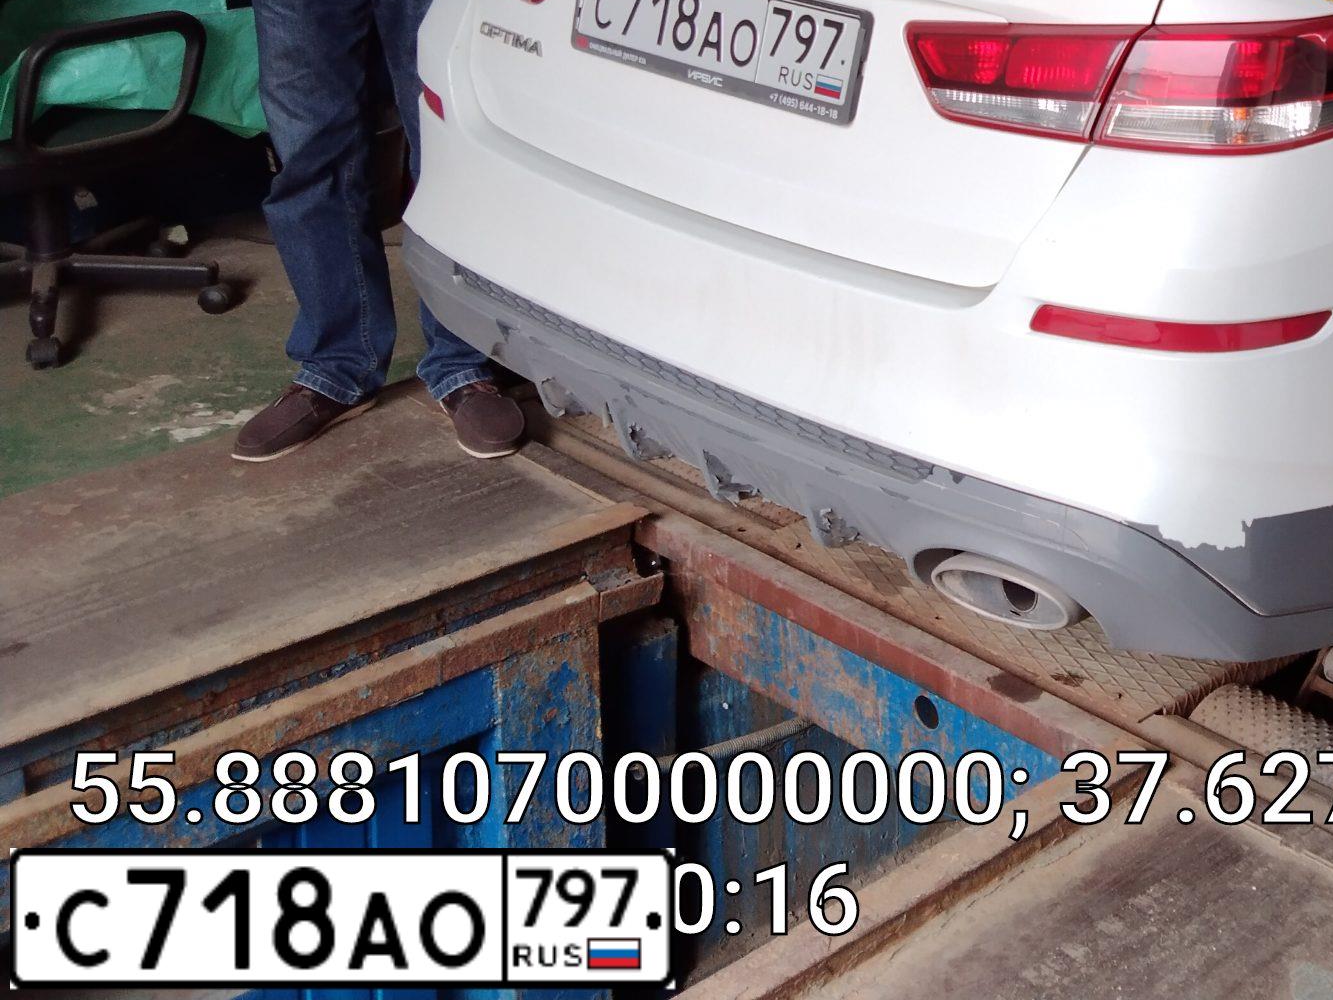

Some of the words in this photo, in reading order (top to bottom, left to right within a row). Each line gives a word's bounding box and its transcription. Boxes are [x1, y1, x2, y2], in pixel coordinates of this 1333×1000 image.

[480, 21, 543, 58] OPTIMA
[769, 6, 845, 70] 797
[687, 68, 723, 88] ИРБИС
[777, 66, 813, 91] RUS
